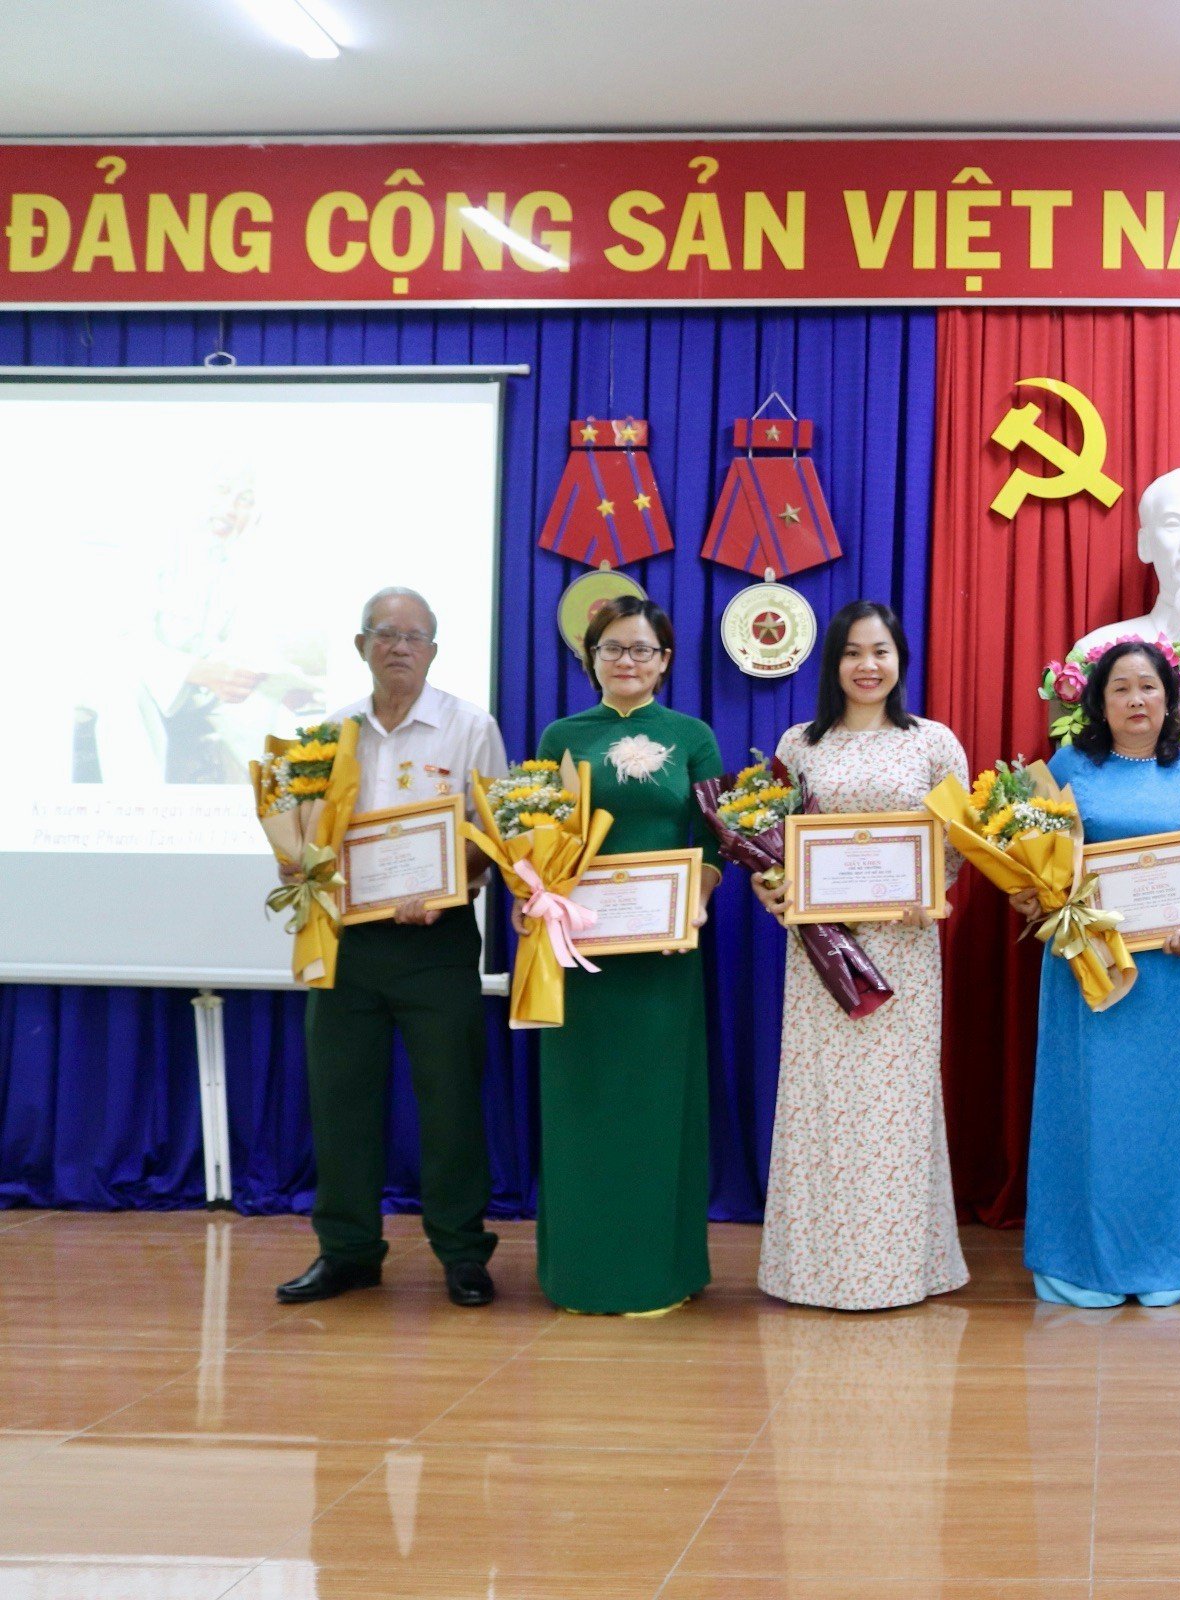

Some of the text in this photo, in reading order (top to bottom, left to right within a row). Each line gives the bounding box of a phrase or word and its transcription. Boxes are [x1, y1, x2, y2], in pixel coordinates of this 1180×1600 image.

[6, 155, 273, 273] ĐẢNG
[305, 168, 573, 294] CỘNG
[604, 156, 805, 272] SẢN
[844, 167, 1072, 291] VIỆT
